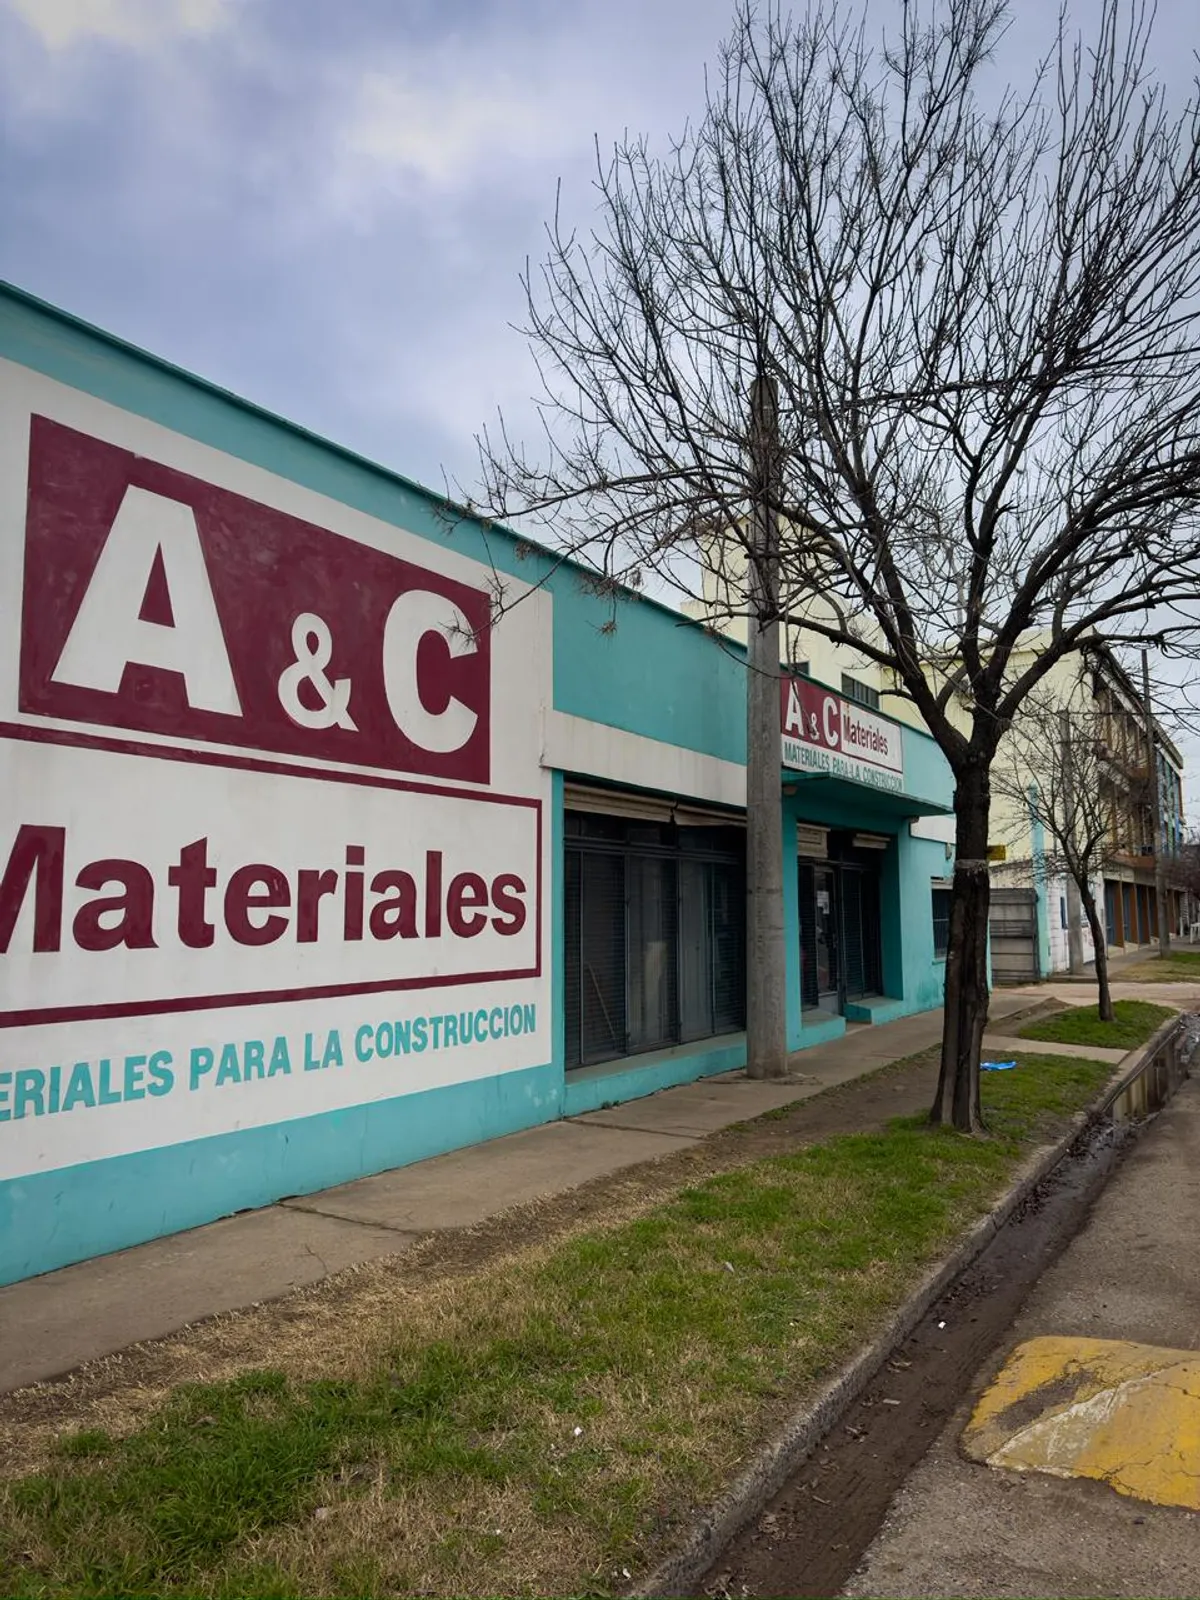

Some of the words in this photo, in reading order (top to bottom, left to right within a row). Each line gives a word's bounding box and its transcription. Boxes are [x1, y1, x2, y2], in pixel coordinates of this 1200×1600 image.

[50, 483, 243, 717] A
[278, 612, 360, 732] &
[382, 589, 479, 753] C
[843, 714, 889, 756] Materiales
[190, 1035, 292, 1092] PARA
[304, 1028, 344, 1070] LA
[354, 1003, 537, 1063] CONSTRUCCION
